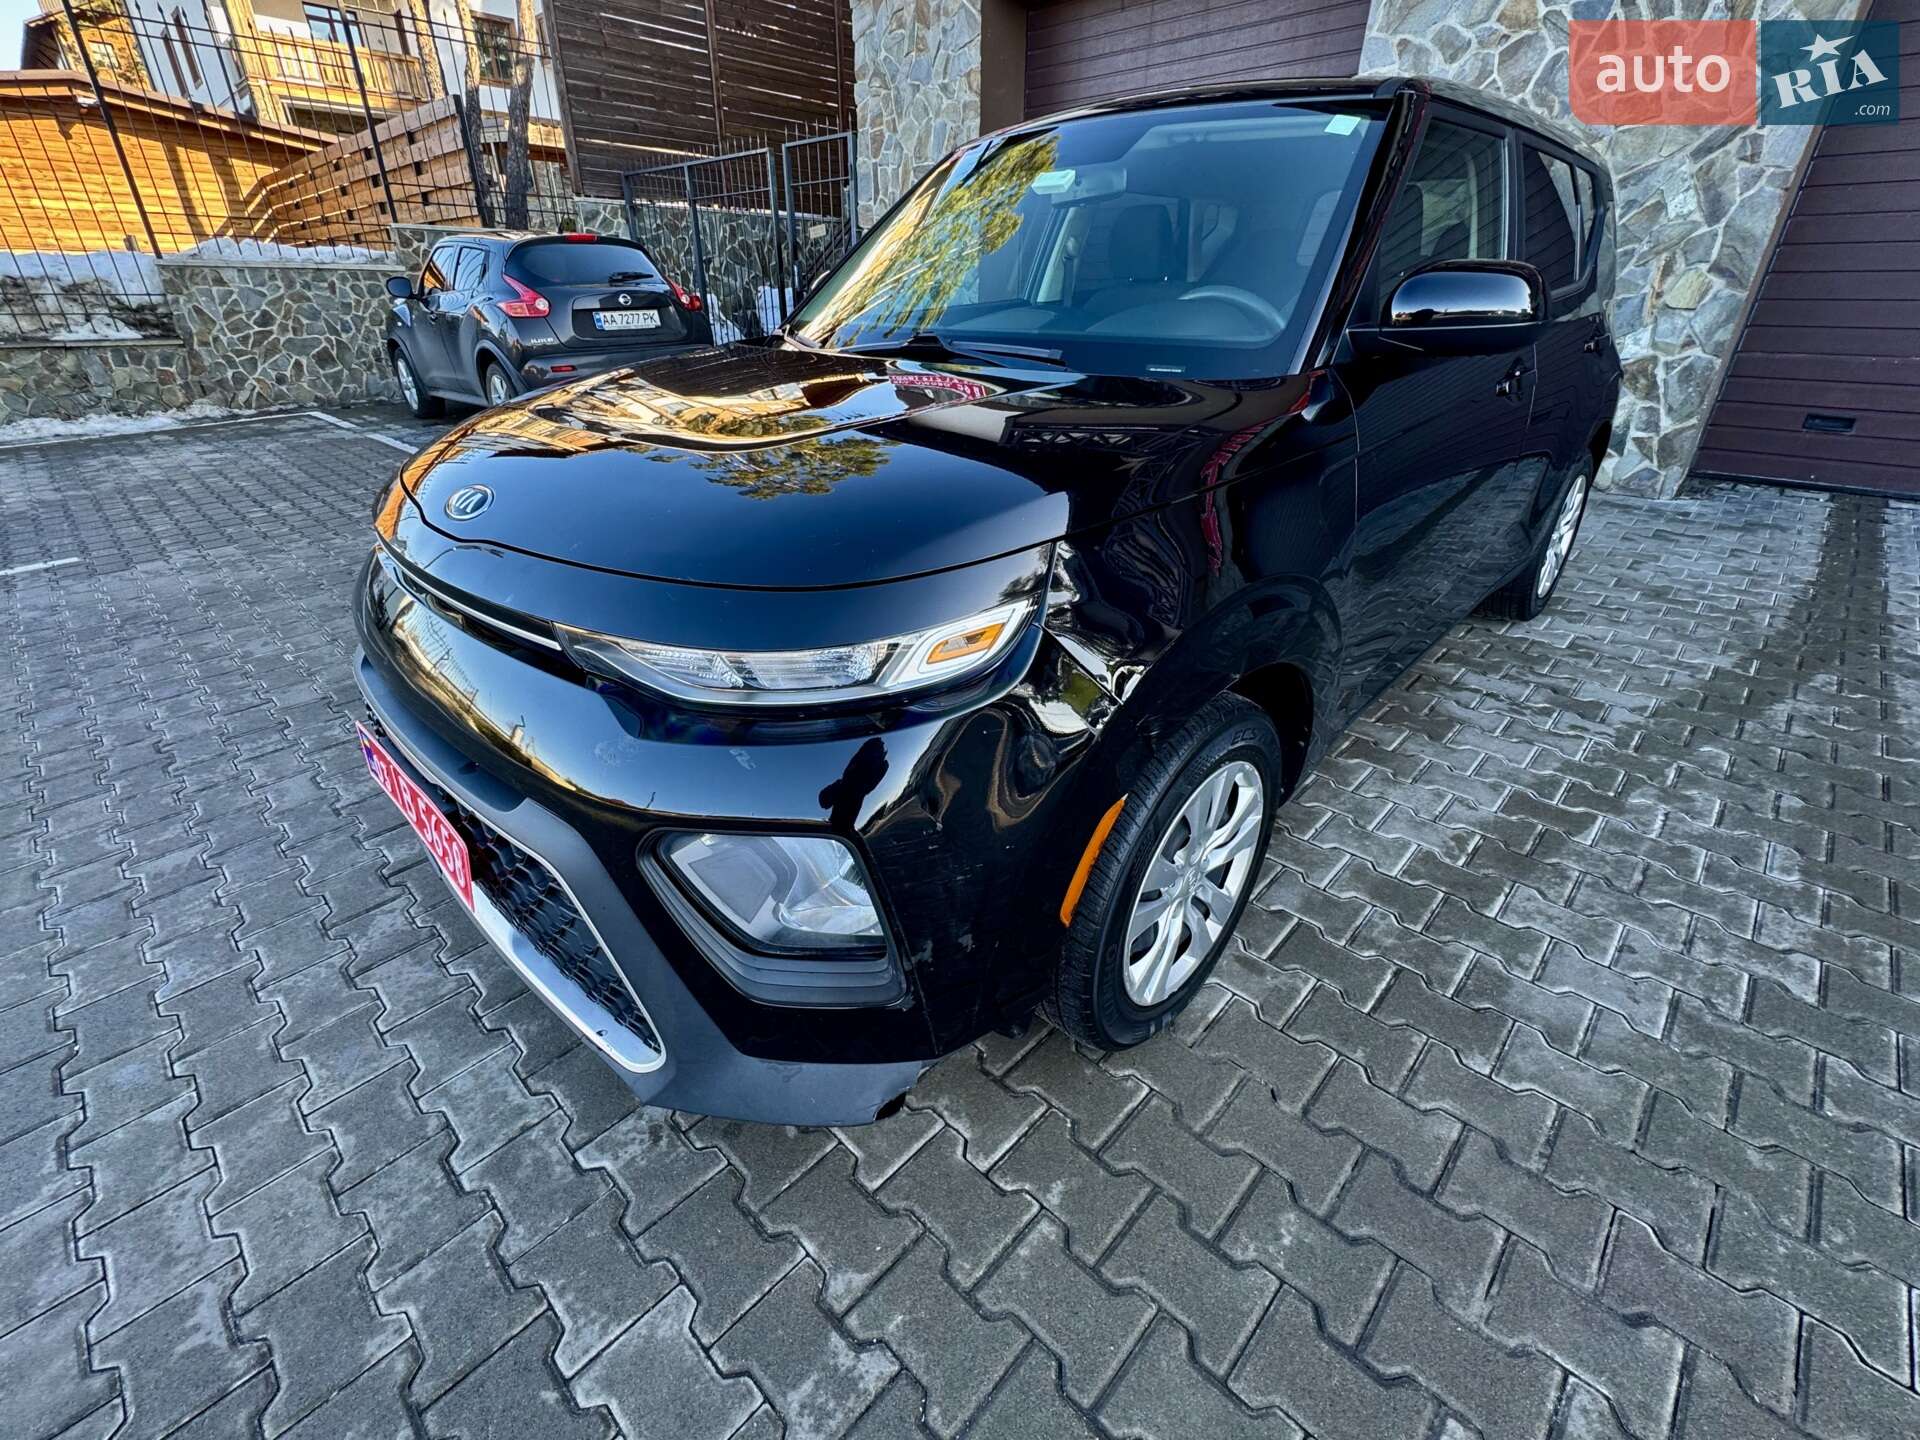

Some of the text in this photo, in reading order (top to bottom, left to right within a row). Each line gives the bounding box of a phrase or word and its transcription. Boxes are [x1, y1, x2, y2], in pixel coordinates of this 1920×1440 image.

[603, 312, 656, 325] AA 7277 PK
